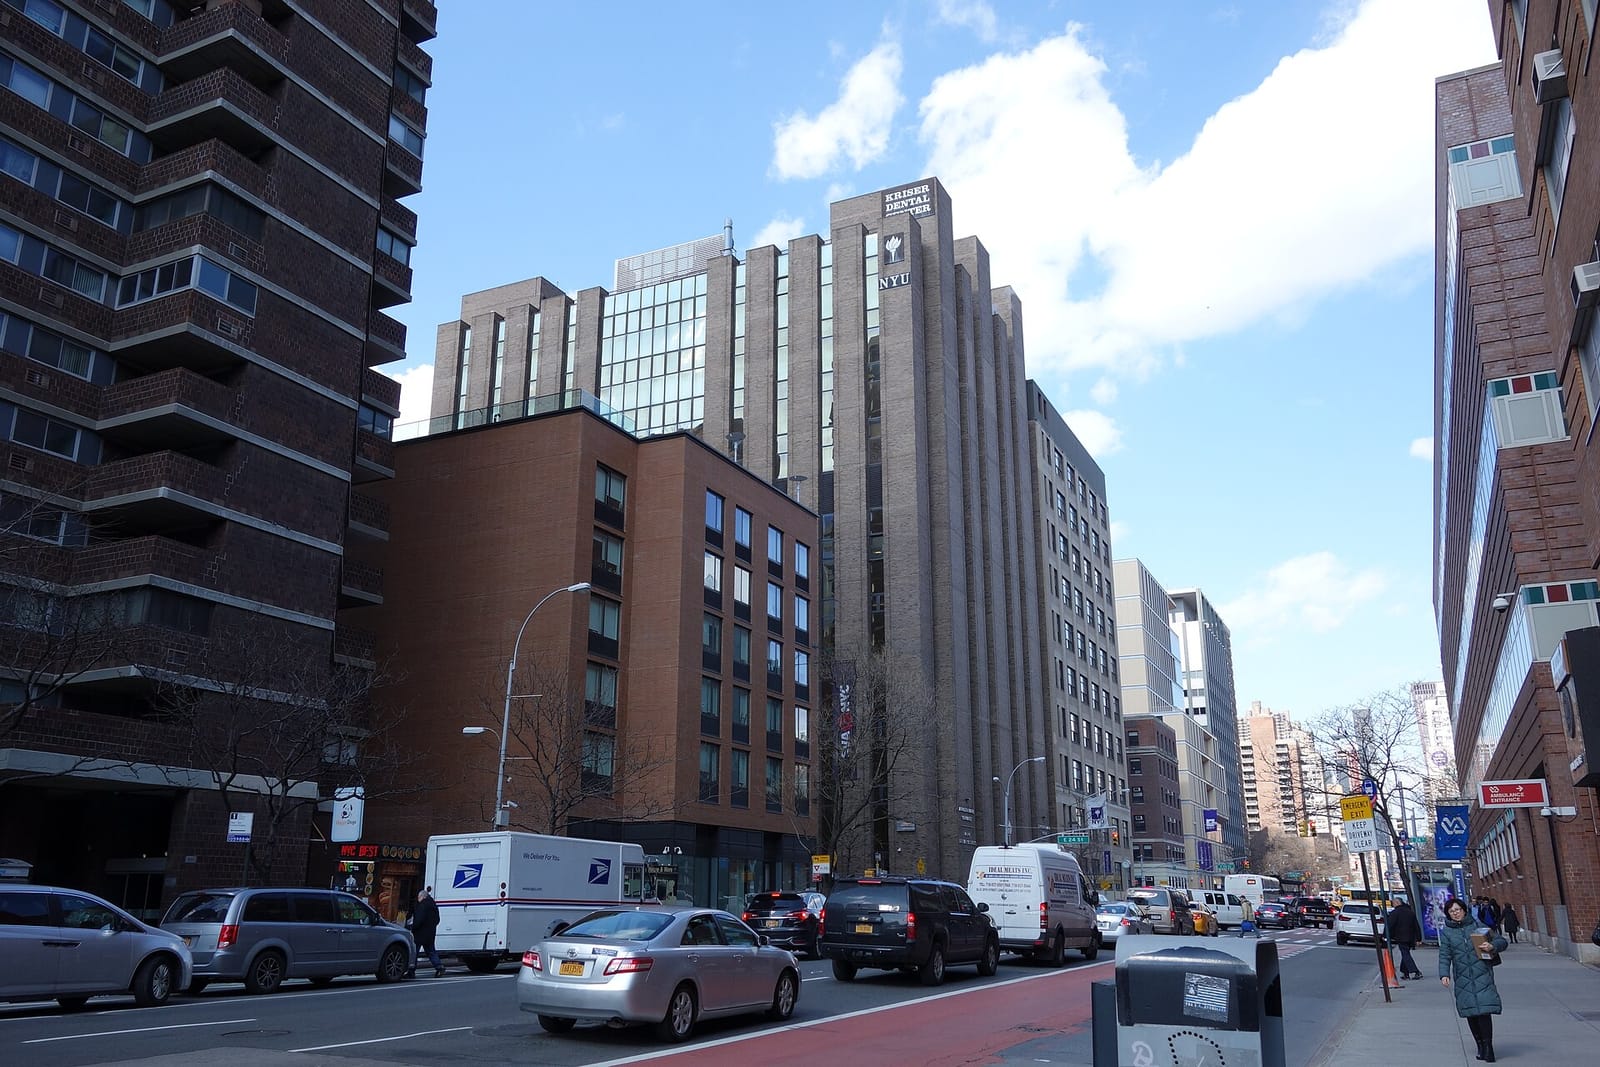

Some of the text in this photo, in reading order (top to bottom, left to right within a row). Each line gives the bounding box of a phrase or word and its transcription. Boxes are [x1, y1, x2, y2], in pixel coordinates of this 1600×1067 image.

[885, 184, 930, 203] KRISER
[885, 194, 930, 212] DENTAL
[886, 204, 931, 217] TER
[879, 272, 910, 290] NYU
[1343, 800, 1369, 811] EMERGENCY
[1350, 811, 1365, 819] EXIT
[1352, 821, 1367, 829] KEEP
[1348, 831, 1372, 840] DRIVEWAY
[1353, 840, 1372, 849] CLEAR
[341, 845, 380, 857] NYC BEST
